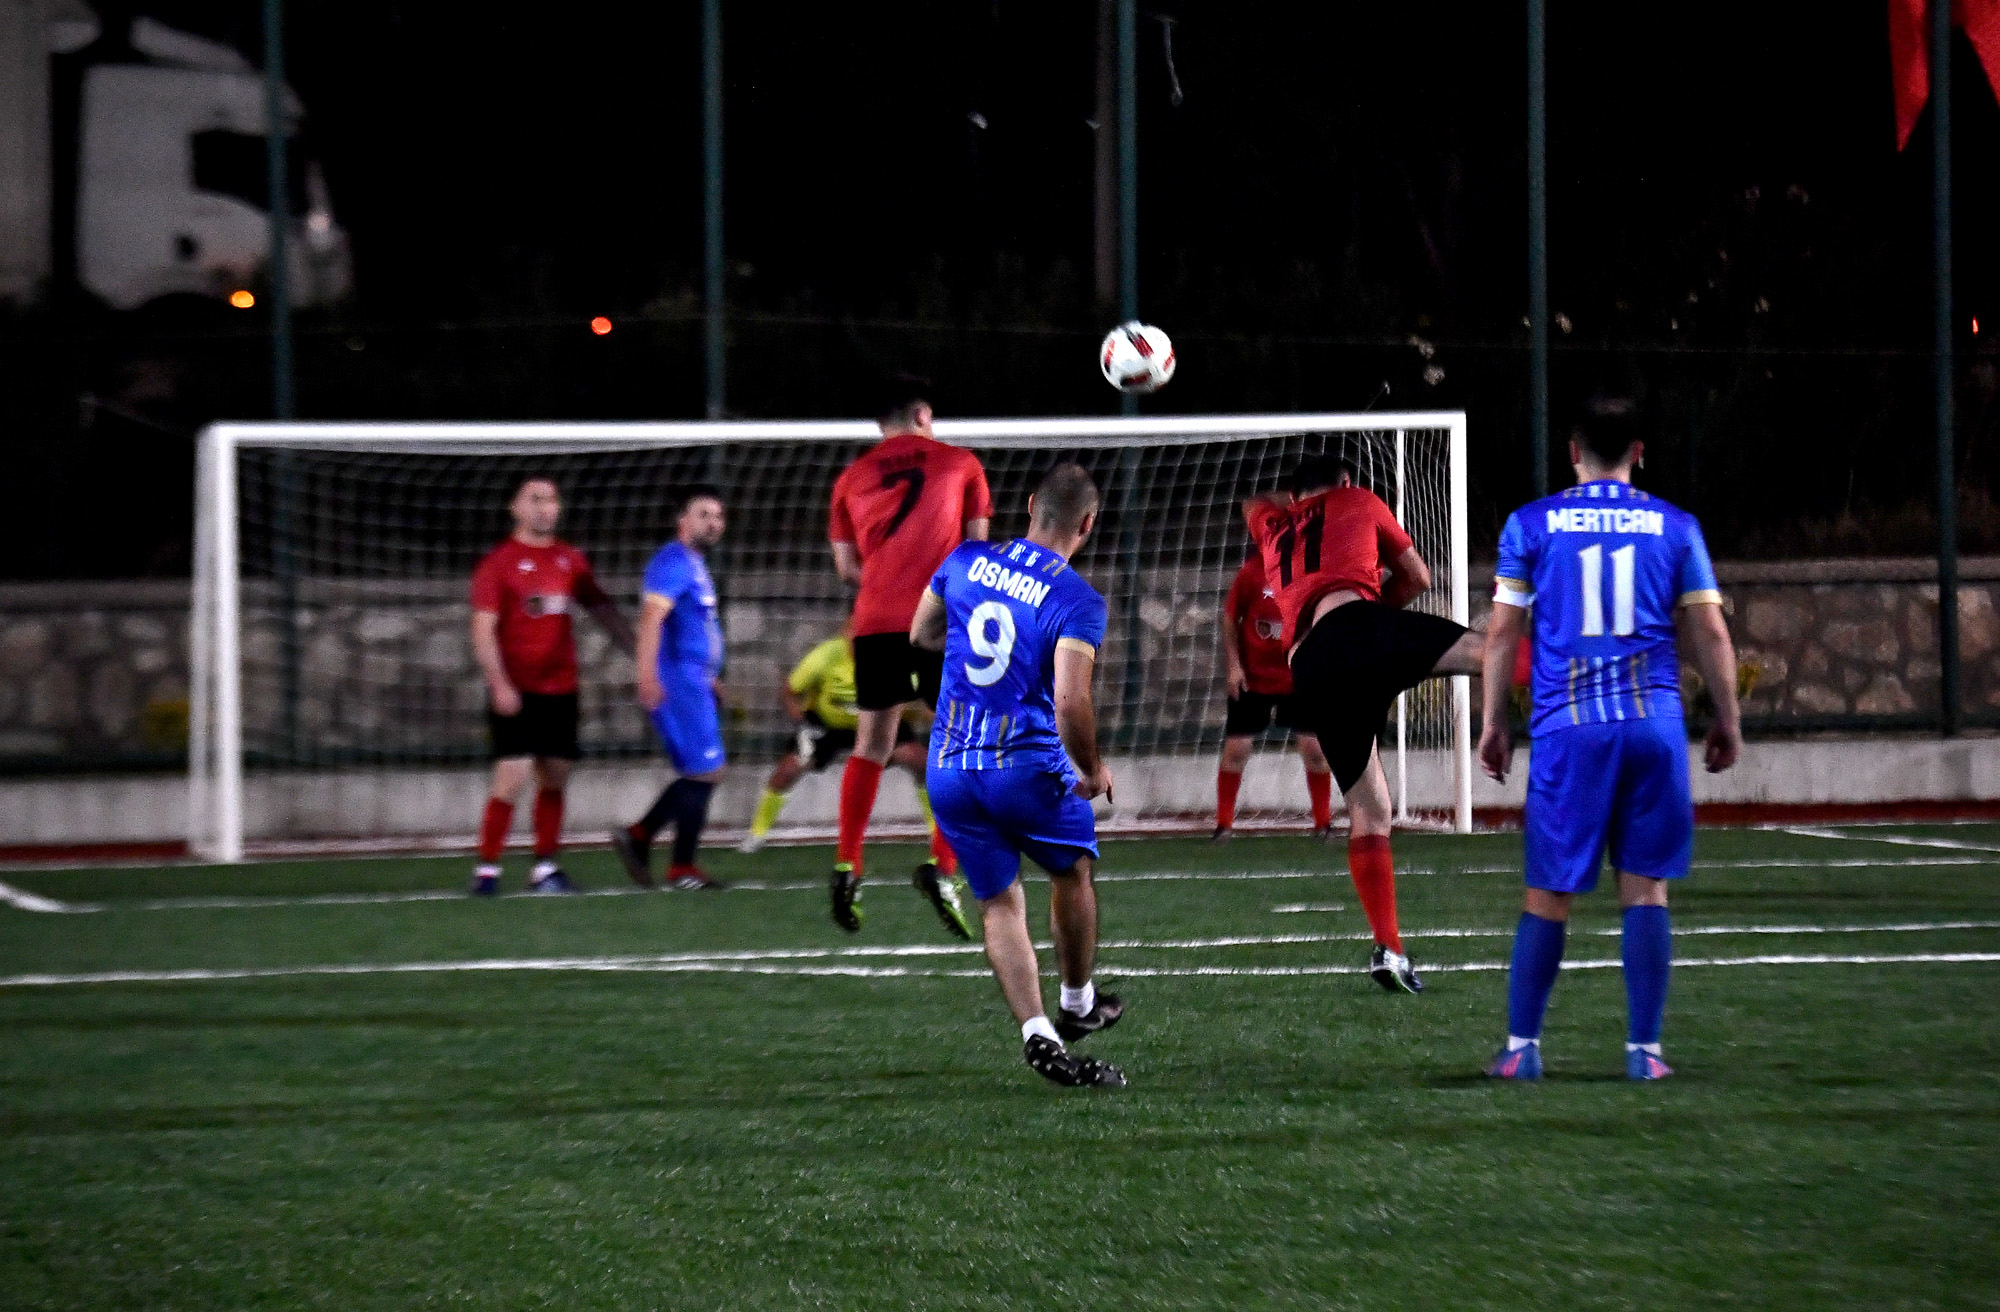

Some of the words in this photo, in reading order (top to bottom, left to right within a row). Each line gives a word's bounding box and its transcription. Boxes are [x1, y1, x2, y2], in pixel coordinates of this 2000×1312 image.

[881, 466, 926, 540] 7
[1546, 508, 1663, 536] MERTCAN
[967, 556, 1051, 608] OSMAN
[1274, 511, 1325, 588] 11
[1577, 543, 1636, 636] 11
[964, 600, 1016, 687] 9
